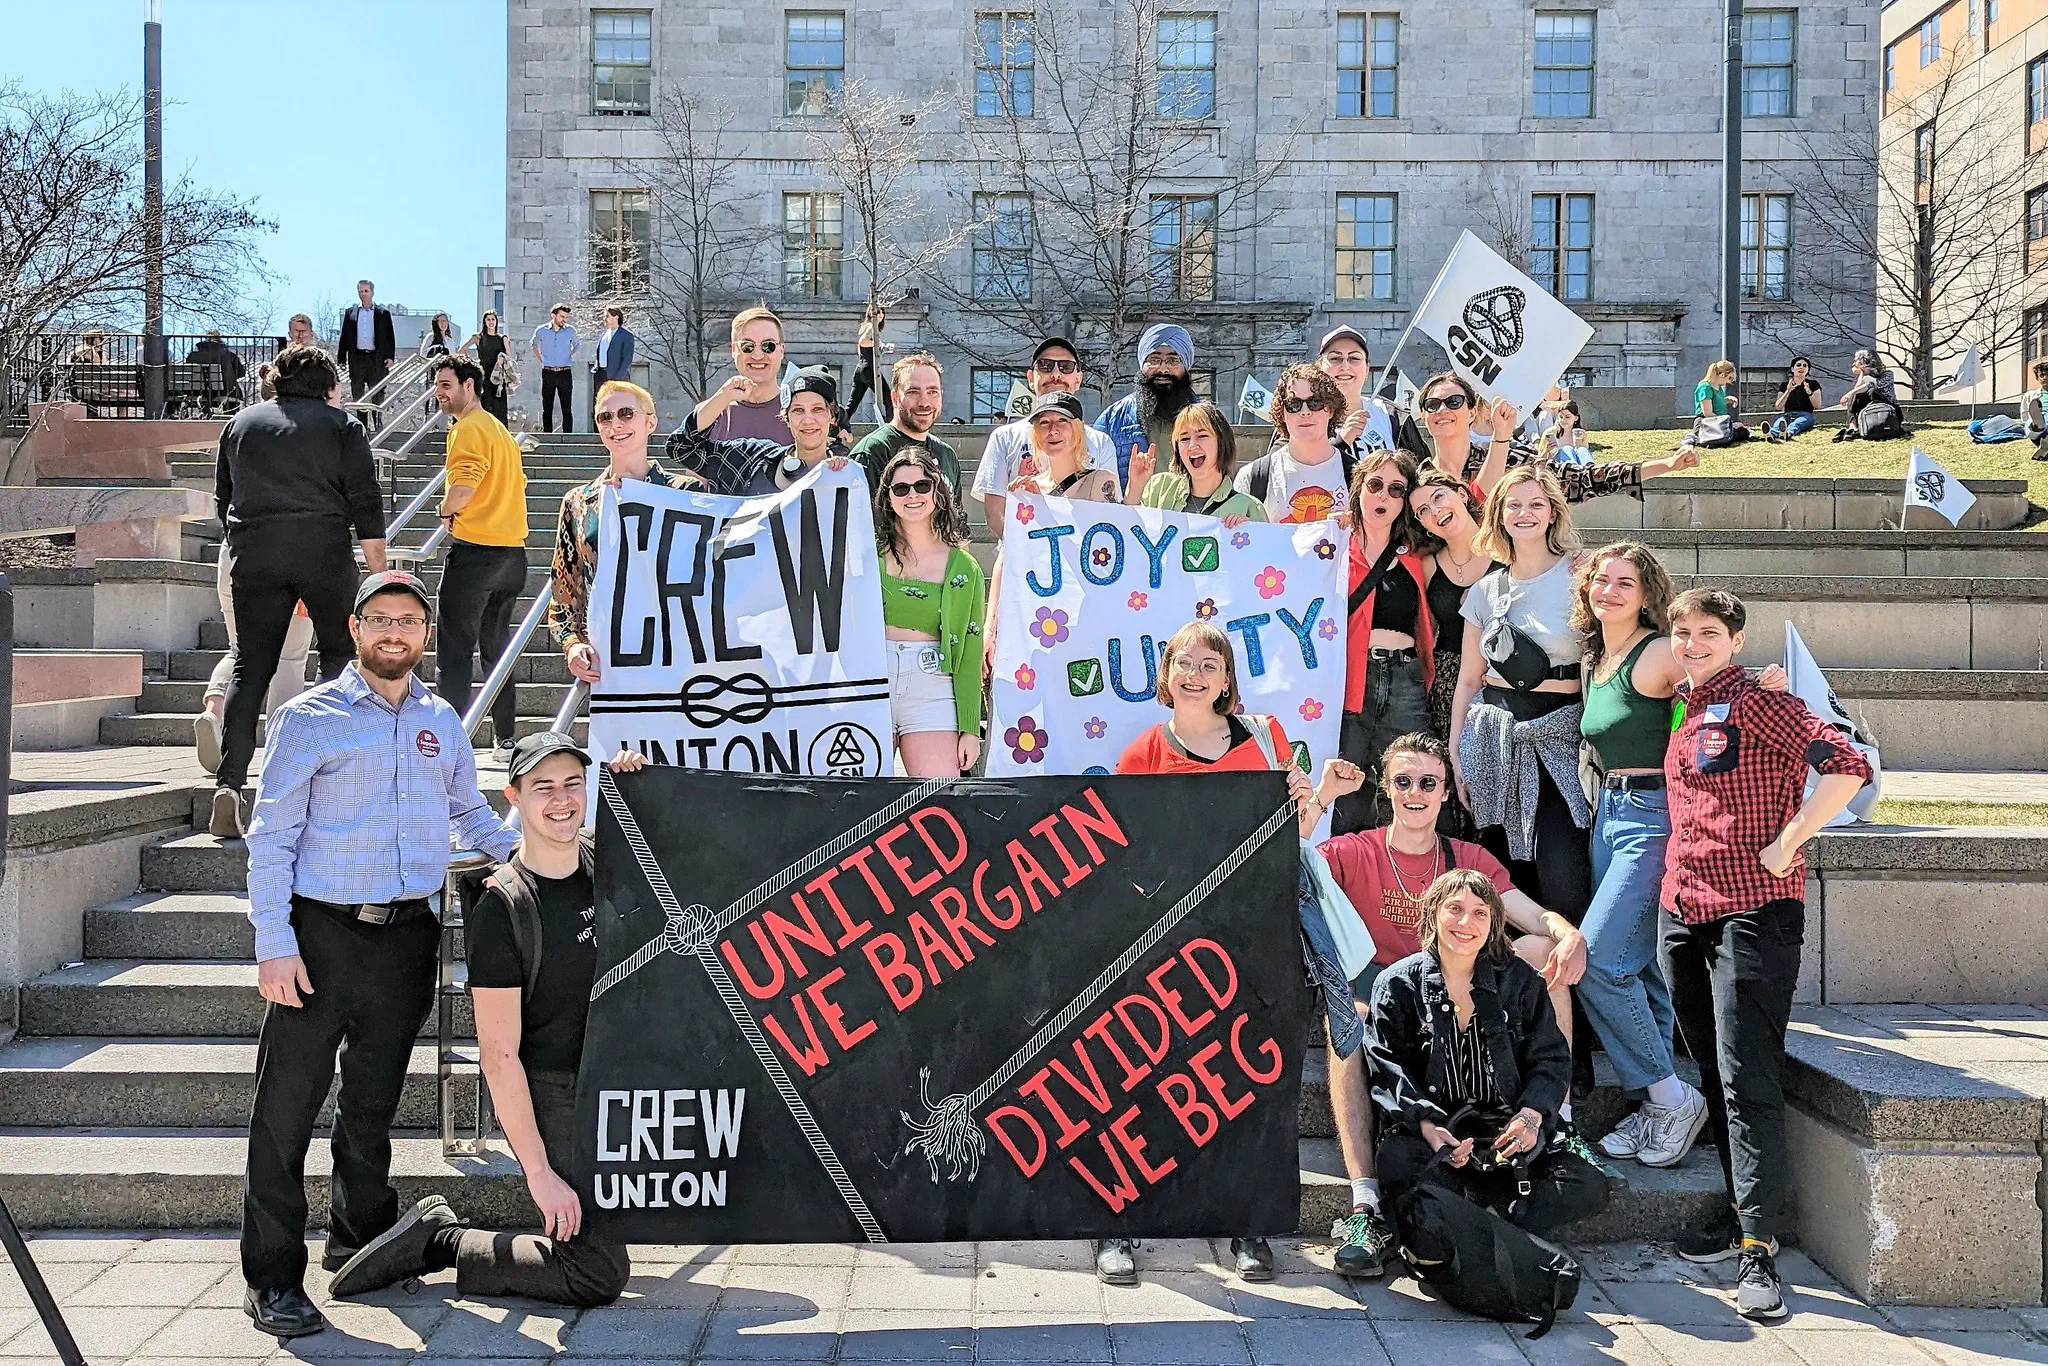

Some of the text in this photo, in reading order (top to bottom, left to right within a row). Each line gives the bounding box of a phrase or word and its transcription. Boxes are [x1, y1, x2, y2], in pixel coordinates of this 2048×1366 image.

[1448, 325, 1502, 387] CSN
[610, 487, 849, 668] CREW
[1025, 521, 1179, 598] JOY
[1107, 597, 1326, 704] UTY
[576, 926, 593, 943] HOT
[721, 806, 969, 999] UNITED
[762, 787, 1128, 1076] WE BARGAIN
[1405, 908, 1420, 917] VIV
[985, 938, 1238, 1178] DIVIDED
[595, 1087, 746, 1162] CREW
[1070, 1014, 1284, 1212] WE BEG
[594, 1169, 728, 1209] UNION
